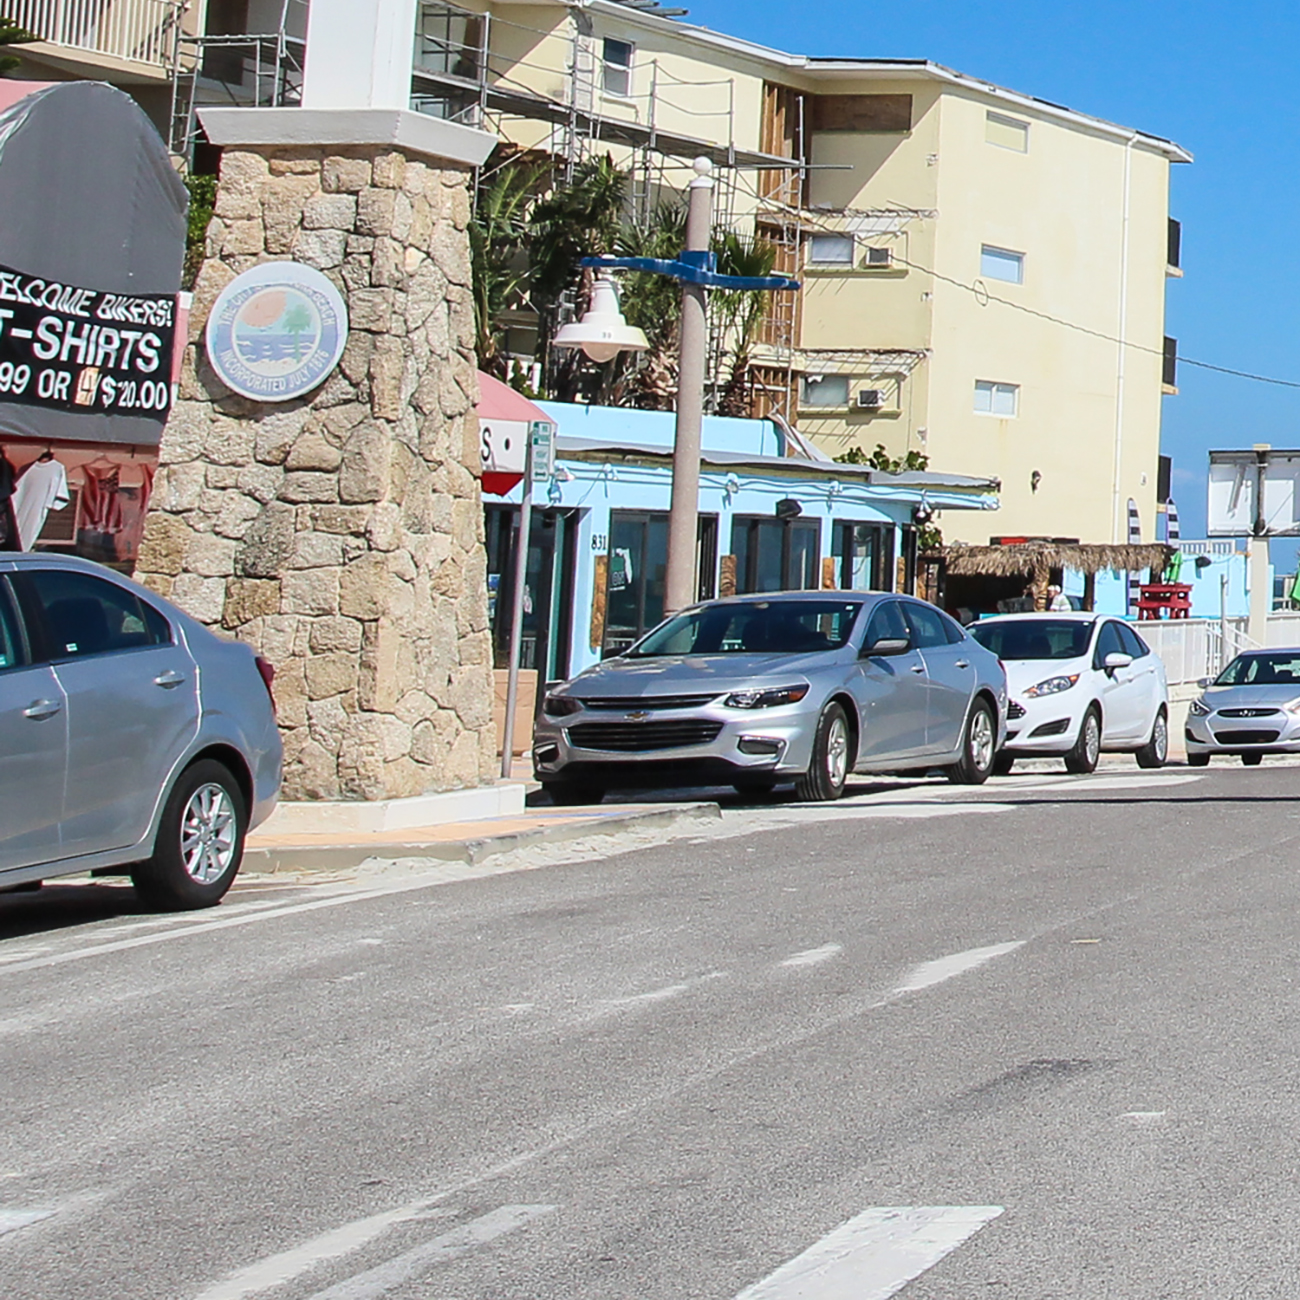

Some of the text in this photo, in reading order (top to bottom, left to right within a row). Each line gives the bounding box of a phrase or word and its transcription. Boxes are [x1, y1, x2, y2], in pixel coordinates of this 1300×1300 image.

[0, 271, 173, 328] ELCOME BIKERS!
[38, 368, 71, 400] OR
[220, 348, 330, 391] INCORPORATED JULY 1876
[591, 534, 607, 550] 831
